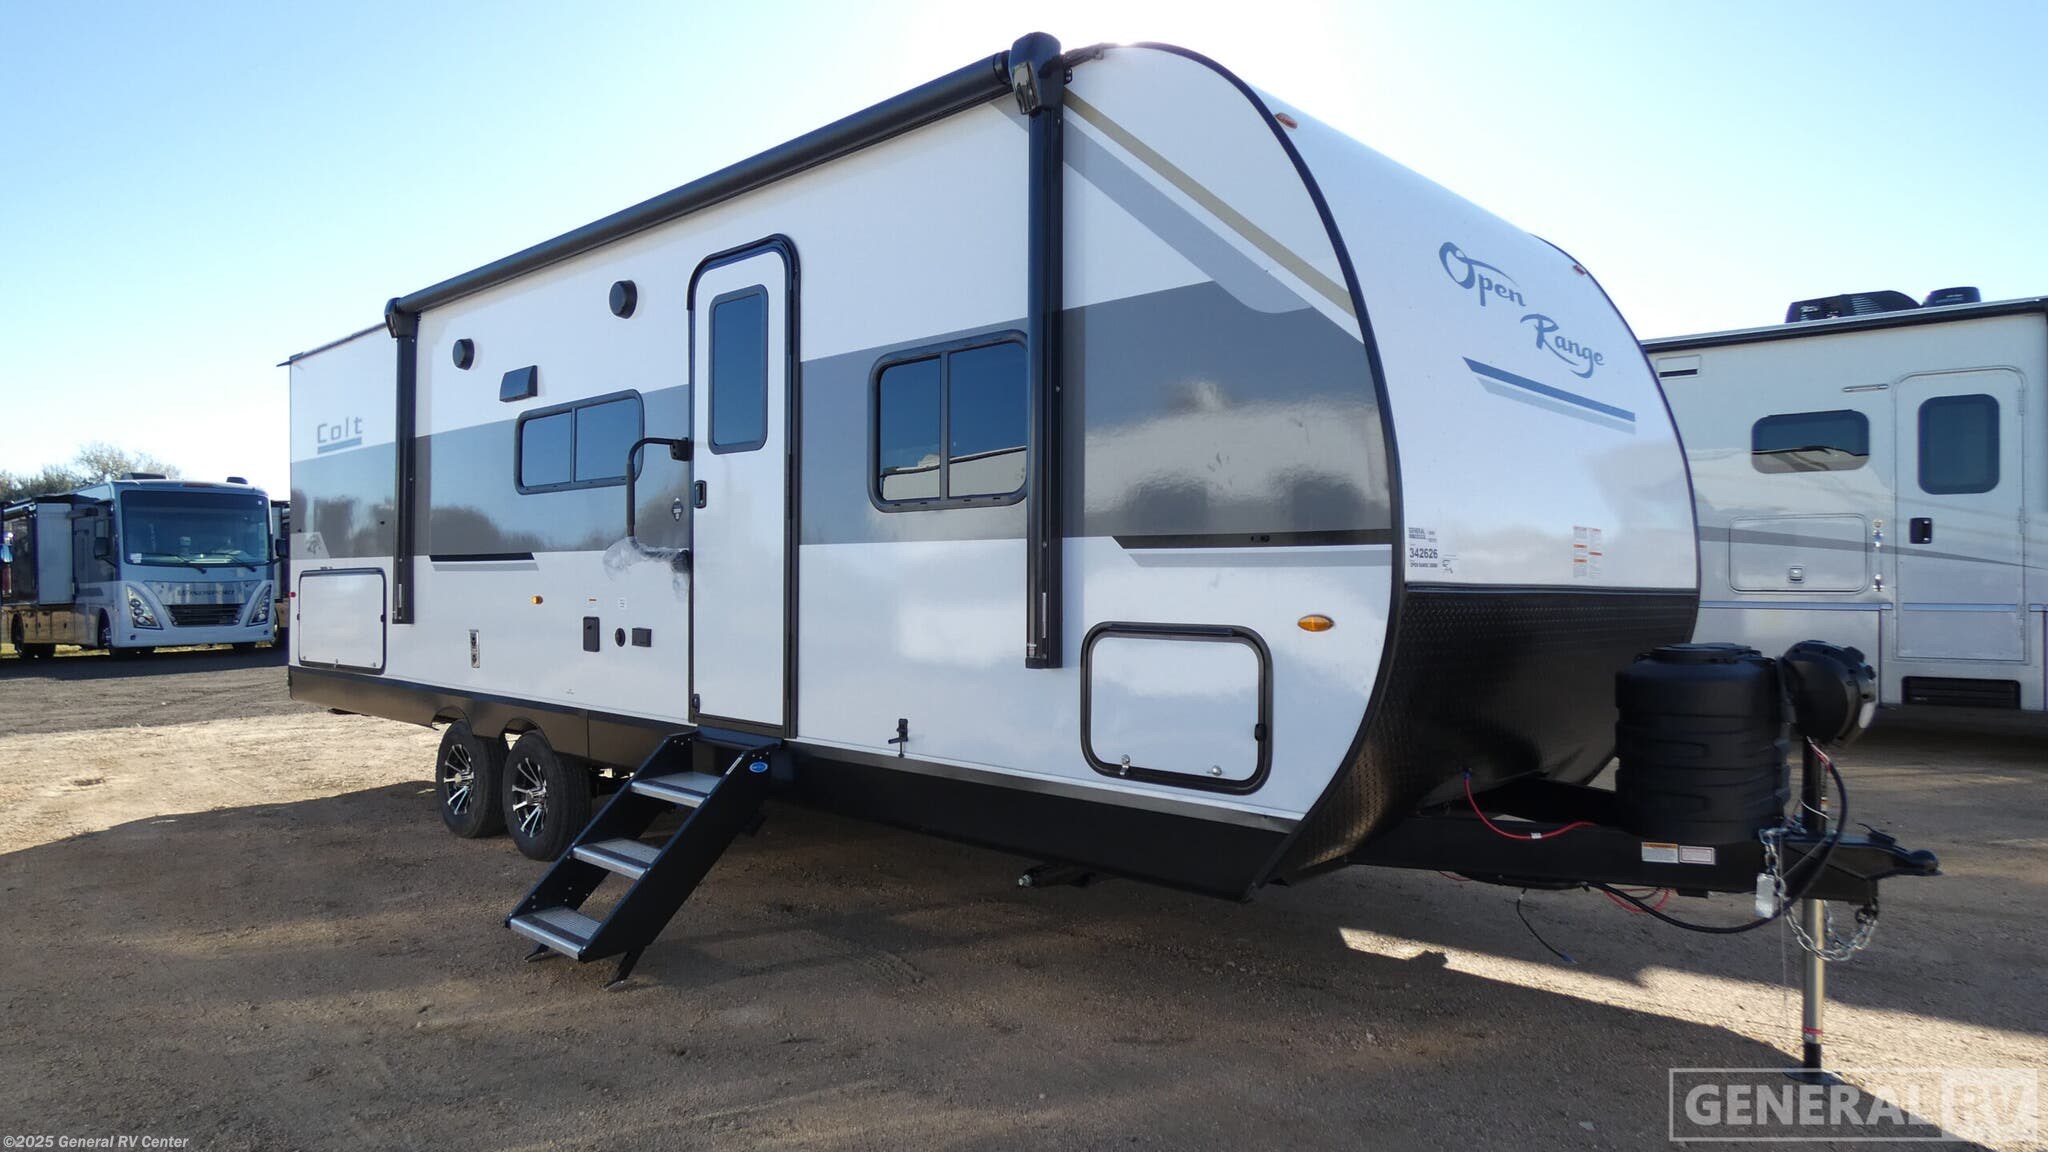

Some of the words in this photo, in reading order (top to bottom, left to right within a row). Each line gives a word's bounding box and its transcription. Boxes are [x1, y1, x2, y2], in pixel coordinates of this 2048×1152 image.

[1439, 241, 1526, 307] Open
[1520, 313, 1605, 378] Range
[317, 416, 362, 444] Colt
[1409, 547, 1438, 559] 342626
